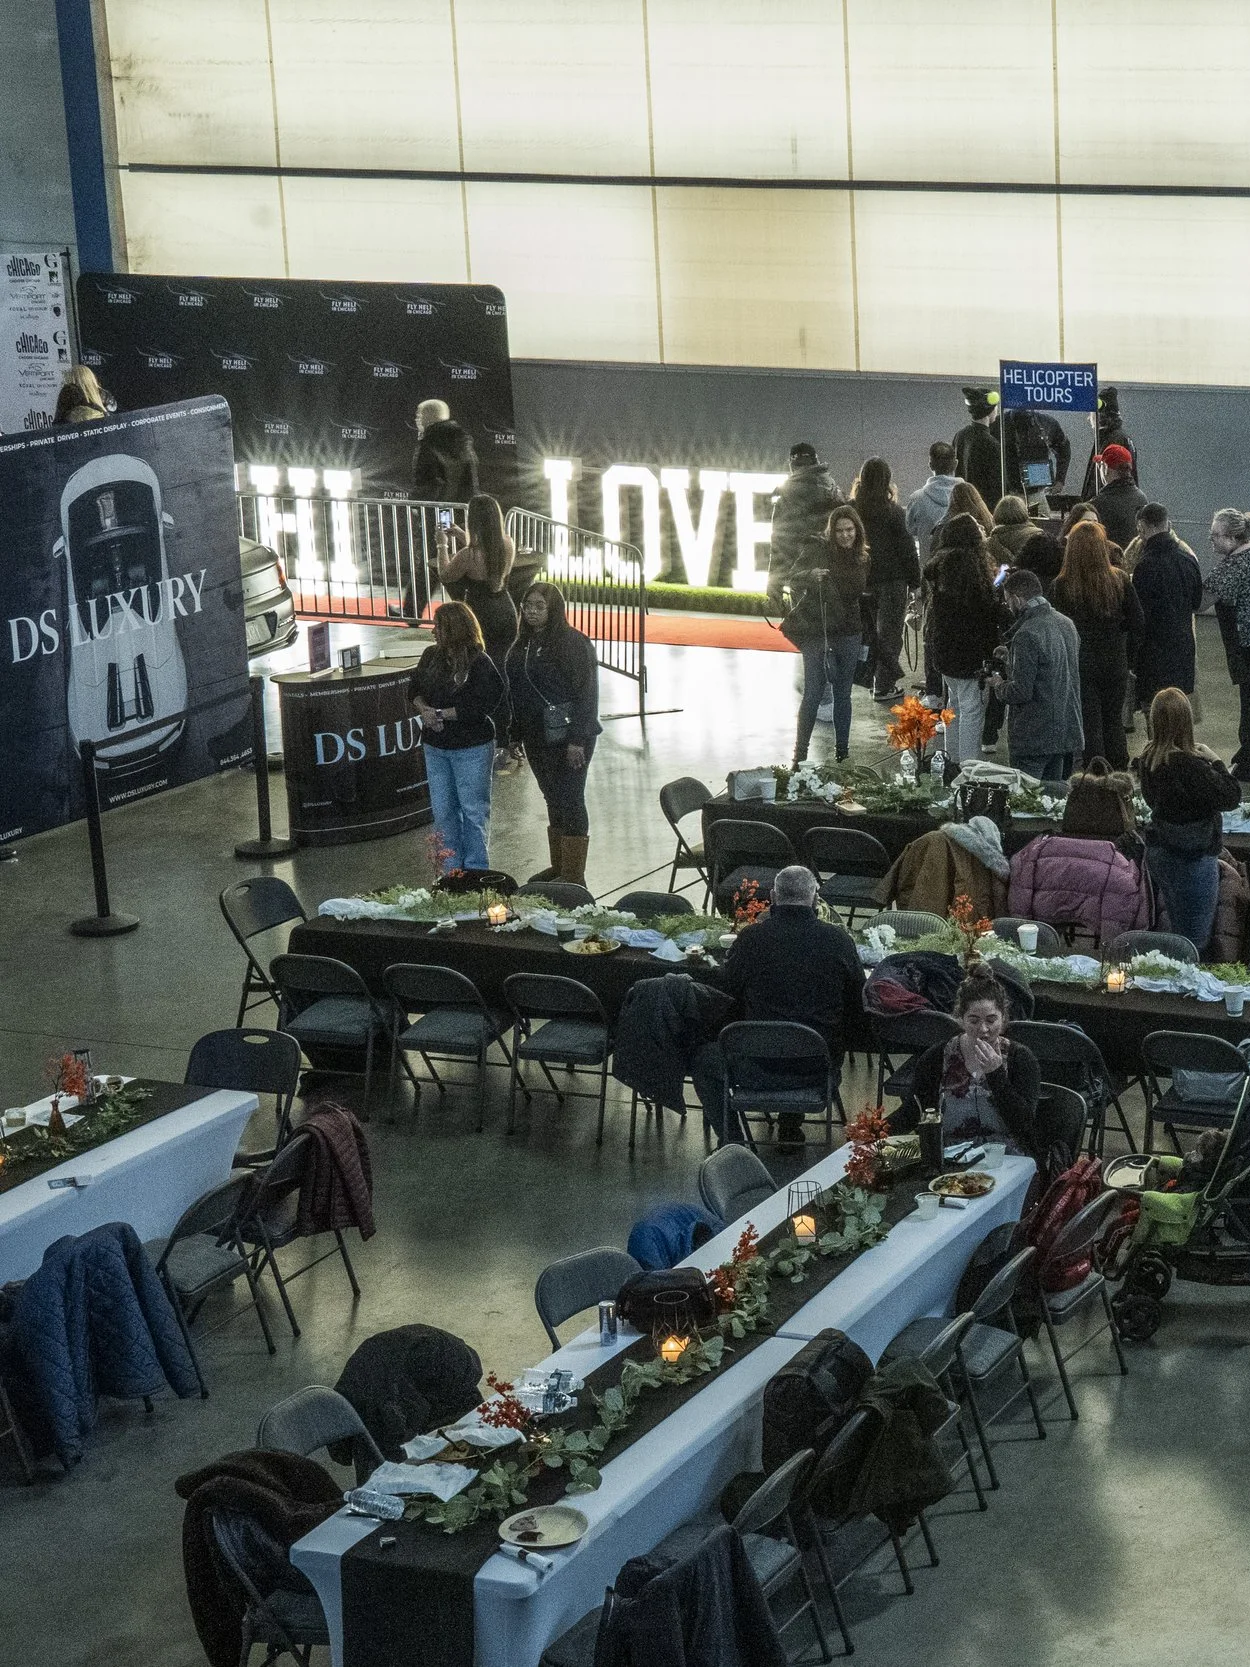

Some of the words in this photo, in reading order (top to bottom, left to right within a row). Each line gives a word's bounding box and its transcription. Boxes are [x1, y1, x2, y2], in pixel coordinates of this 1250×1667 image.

[7, 256, 40, 276] CHICAGO
[16, 332, 49, 353] CHICAGO
[1004, 369, 1094, 386] HELICOPTER
[1024, 387, 1072, 403] TOURS
[24, 409, 54, 430] CHICAG
[30, 437, 55, 447] PRIVATE
[57, 432, 79, 443] DRIVER
[83, 428, 102, 437] STATIC
[104, 423, 127, 434] DISPLAY
[131, 415, 166, 427] CORPORATE
[166, 410, 186, 420] EVENTS
[543, 459, 788, 593] LOVE
[8, 609, 59, 663] DS
[68, 569, 206, 648] LUXURY
[314, 728, 366, 765] DS
[377, 714, 424, 757] LUX
[108, 779, 168, 803] WWW.DSLUXURY.COM
